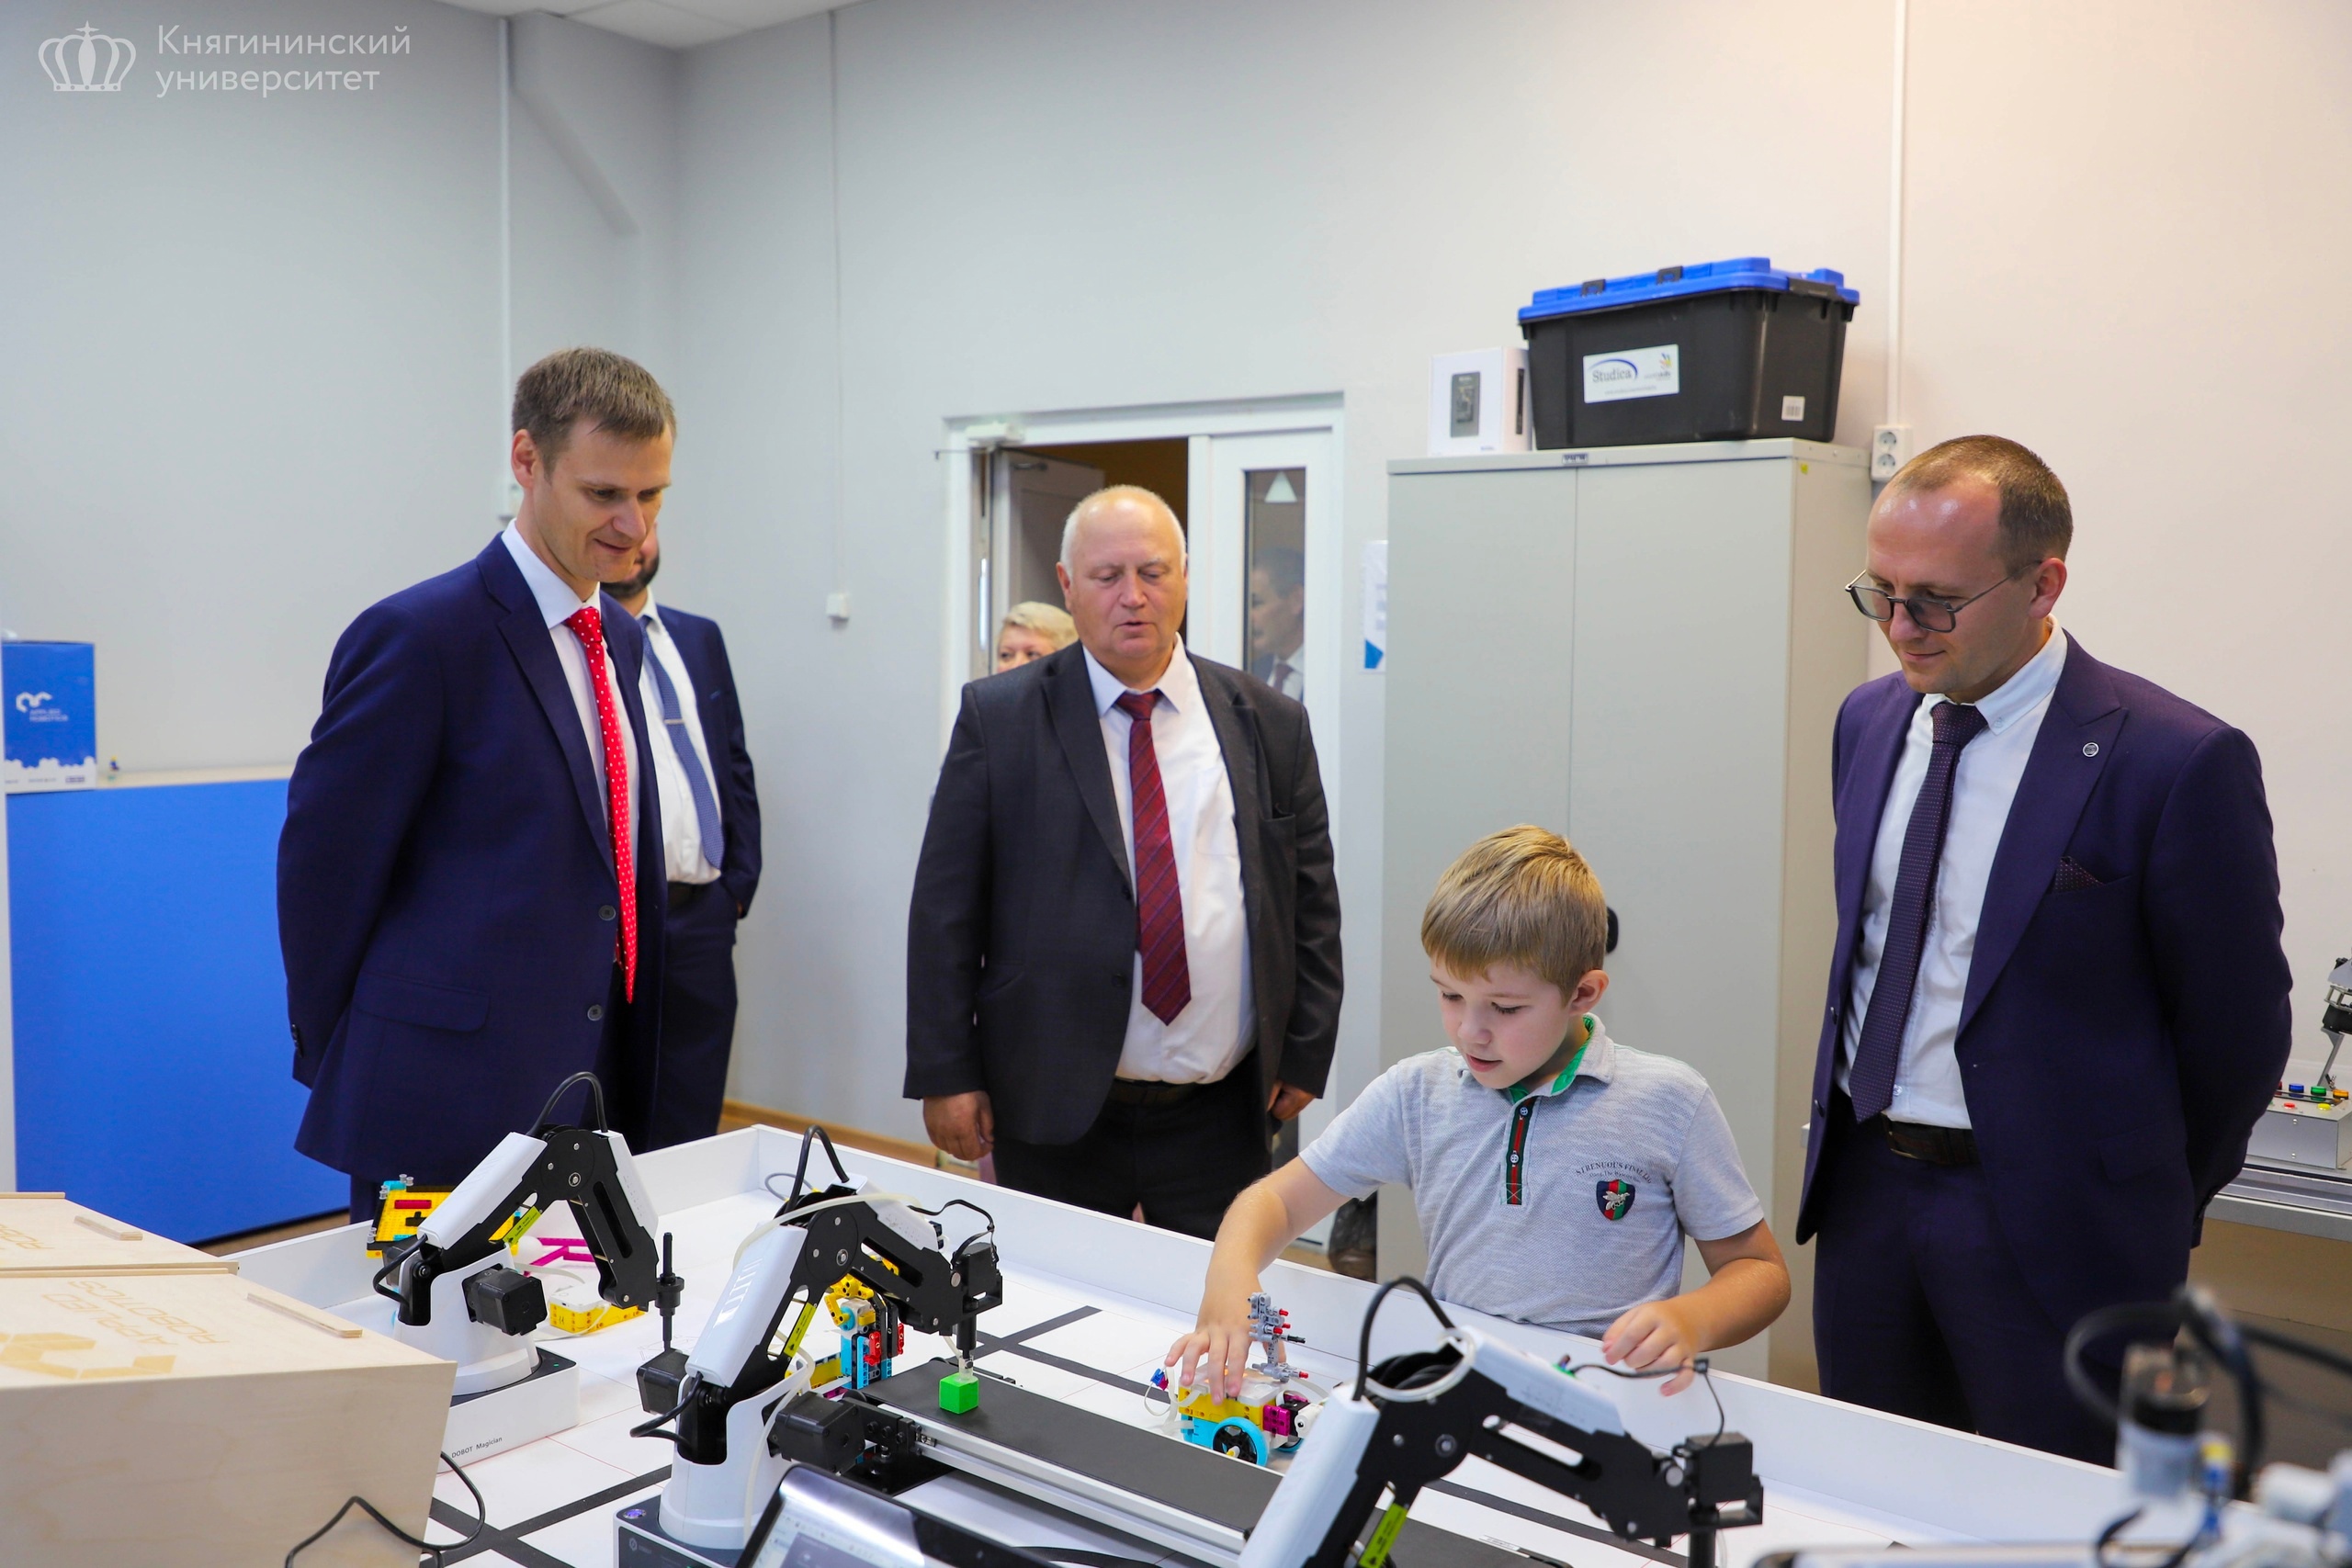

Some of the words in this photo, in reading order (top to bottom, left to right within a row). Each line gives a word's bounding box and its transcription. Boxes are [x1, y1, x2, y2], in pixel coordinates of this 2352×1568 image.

[1592, 368, 1632, 383] Studica
[42, 1293, 178, 1345] APPLIED
[68, 1280, 230, 1344] ROBOTICS
[451, 1446, 473, 1459] DOBOT
[476, 1437, 503, 1450] Magician
